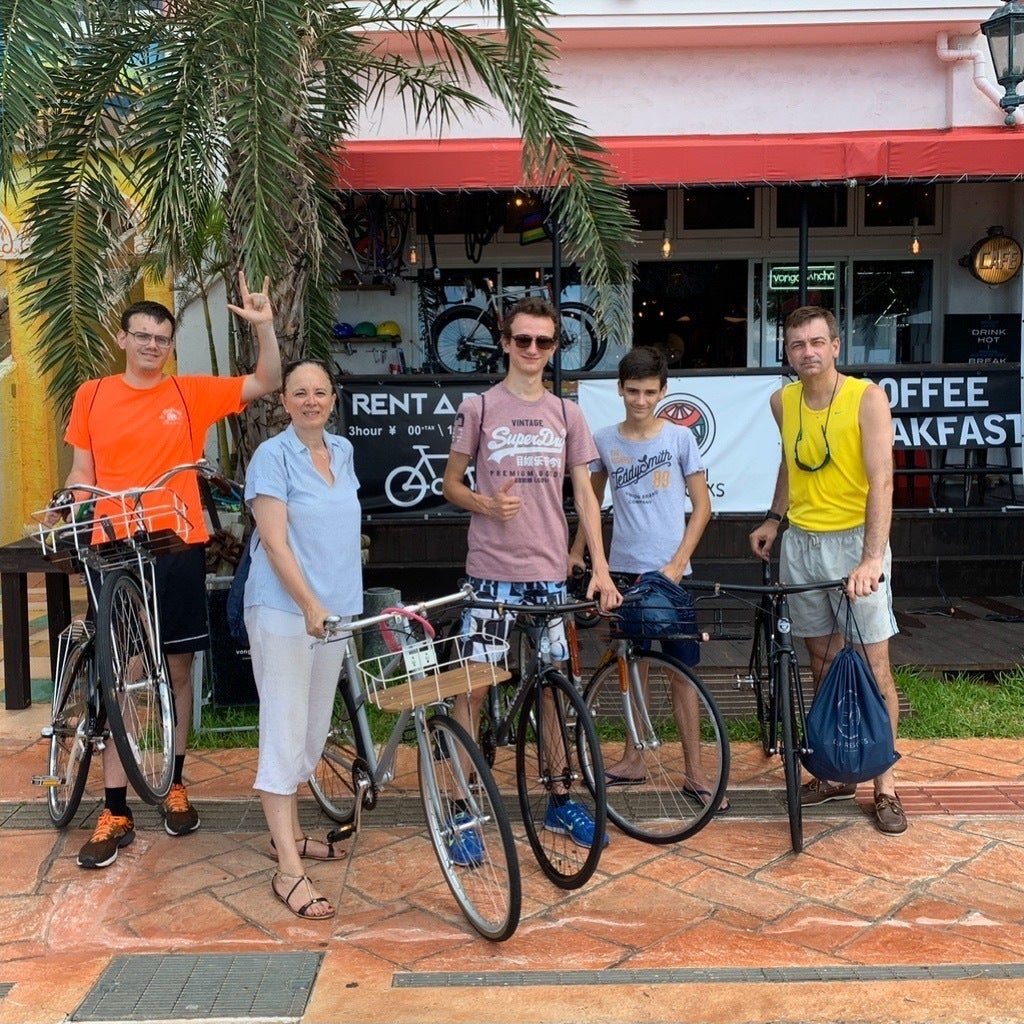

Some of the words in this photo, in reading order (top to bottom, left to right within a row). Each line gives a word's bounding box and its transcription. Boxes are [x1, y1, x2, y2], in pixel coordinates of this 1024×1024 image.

[978, 251, 1018, 270] CAFE
[878, 377, 989, 408] OFFEE
[352, 393, 427, 415] RENT
[349, 426, 383, 436] 3hour
[389, 425, 396, 436] ¥
[512, 419, 544, 428] VINTAGE
[892, 413, 1022, 446] AKFAST
